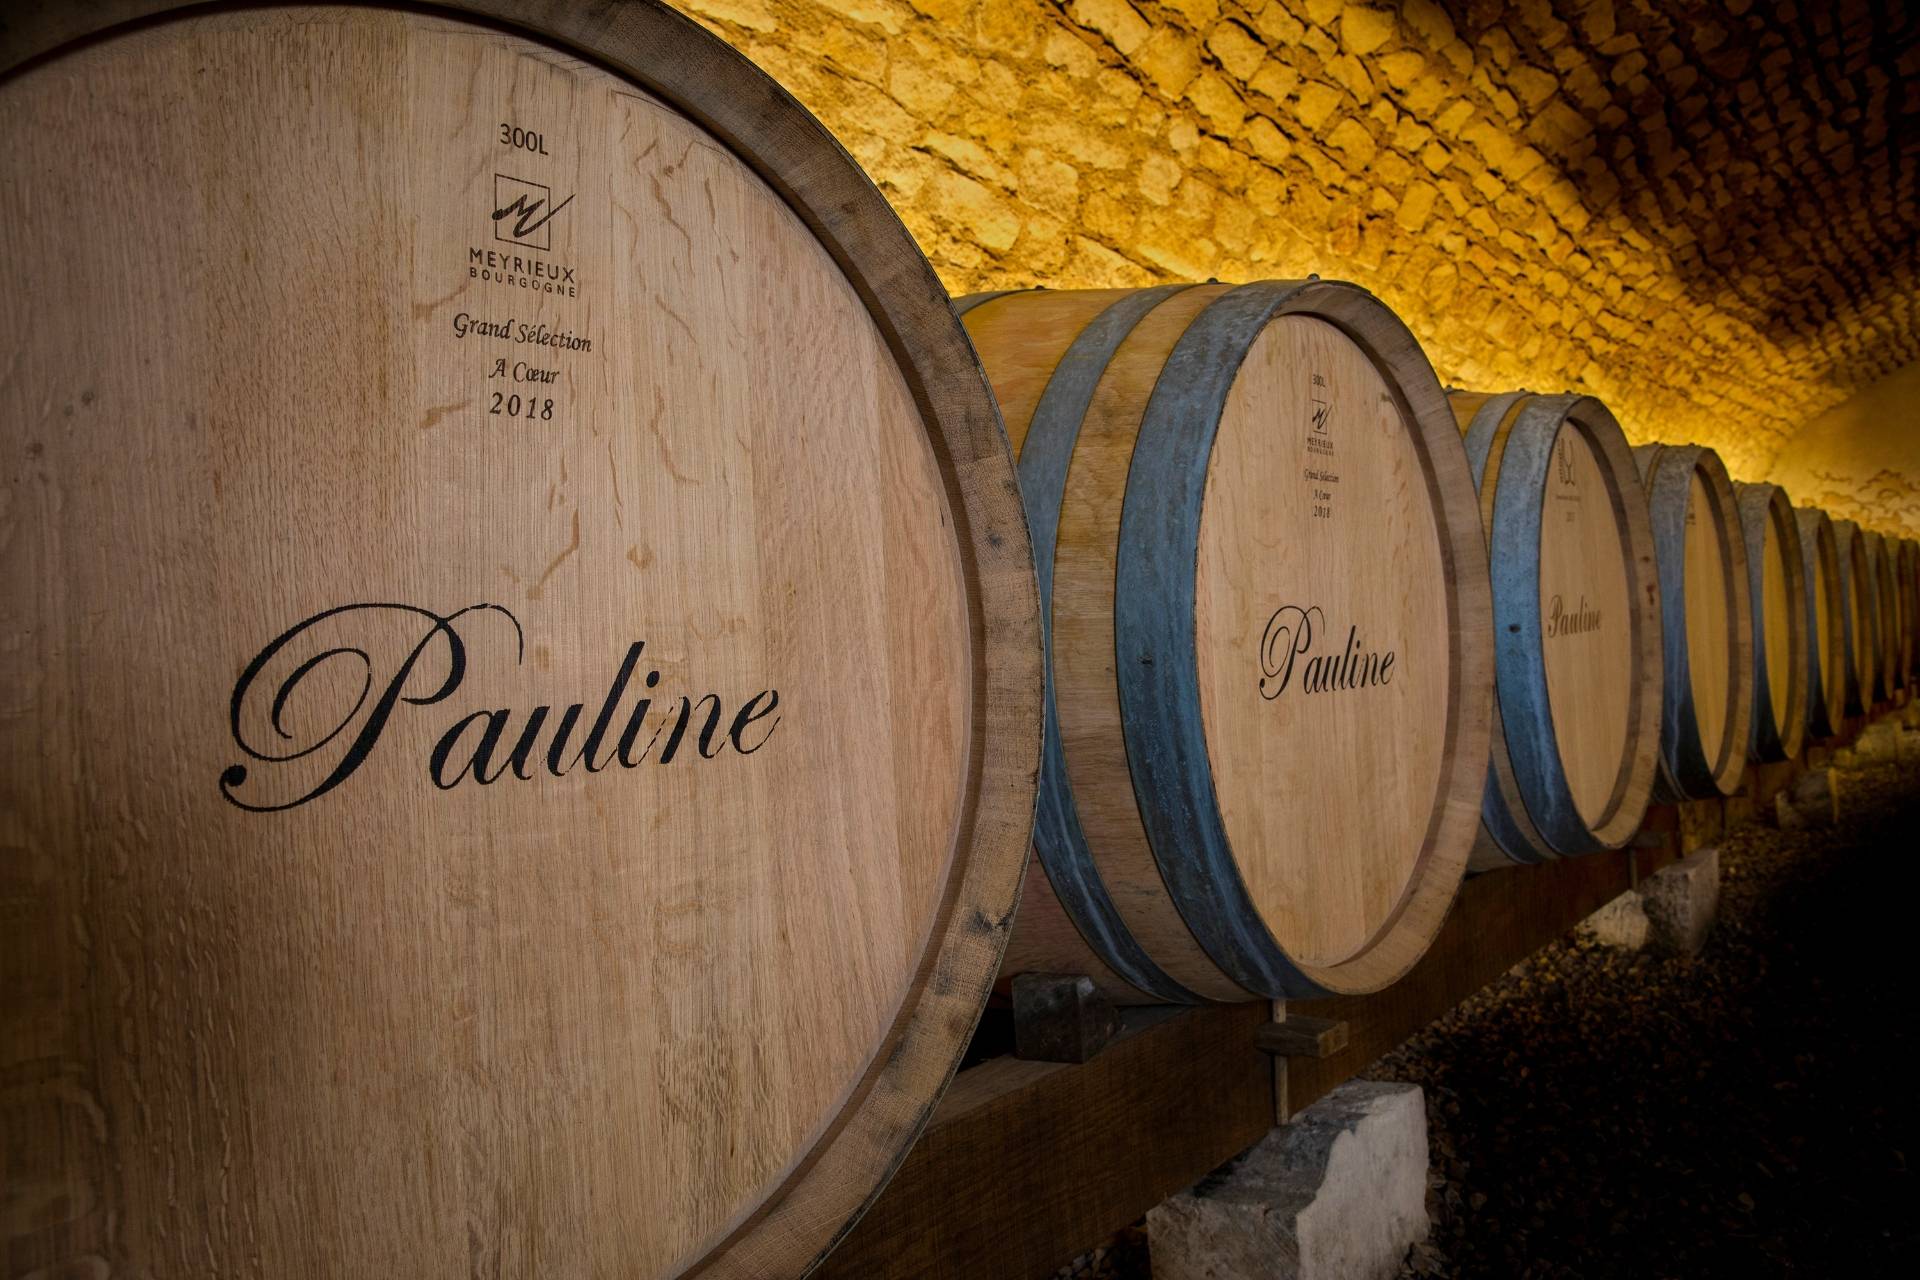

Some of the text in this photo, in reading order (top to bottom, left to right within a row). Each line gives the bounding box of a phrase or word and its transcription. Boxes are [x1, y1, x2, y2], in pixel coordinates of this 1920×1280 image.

[500, 123, 549, 156] 300L
[469, 266, 576, 298] BOURGOGNE
[470, 247, 575, 284] MEYRIEUX
[453, 312, 592, 352] Grand Sélection
[488, 358, 560, 384] A Cœur
[489, 392, 554, 421] 2018
[1548, 594, 1601, 639] Pauline
[1259, 605, 1396, 701] Pauline
[219, 602, 781, 813] Pauline
